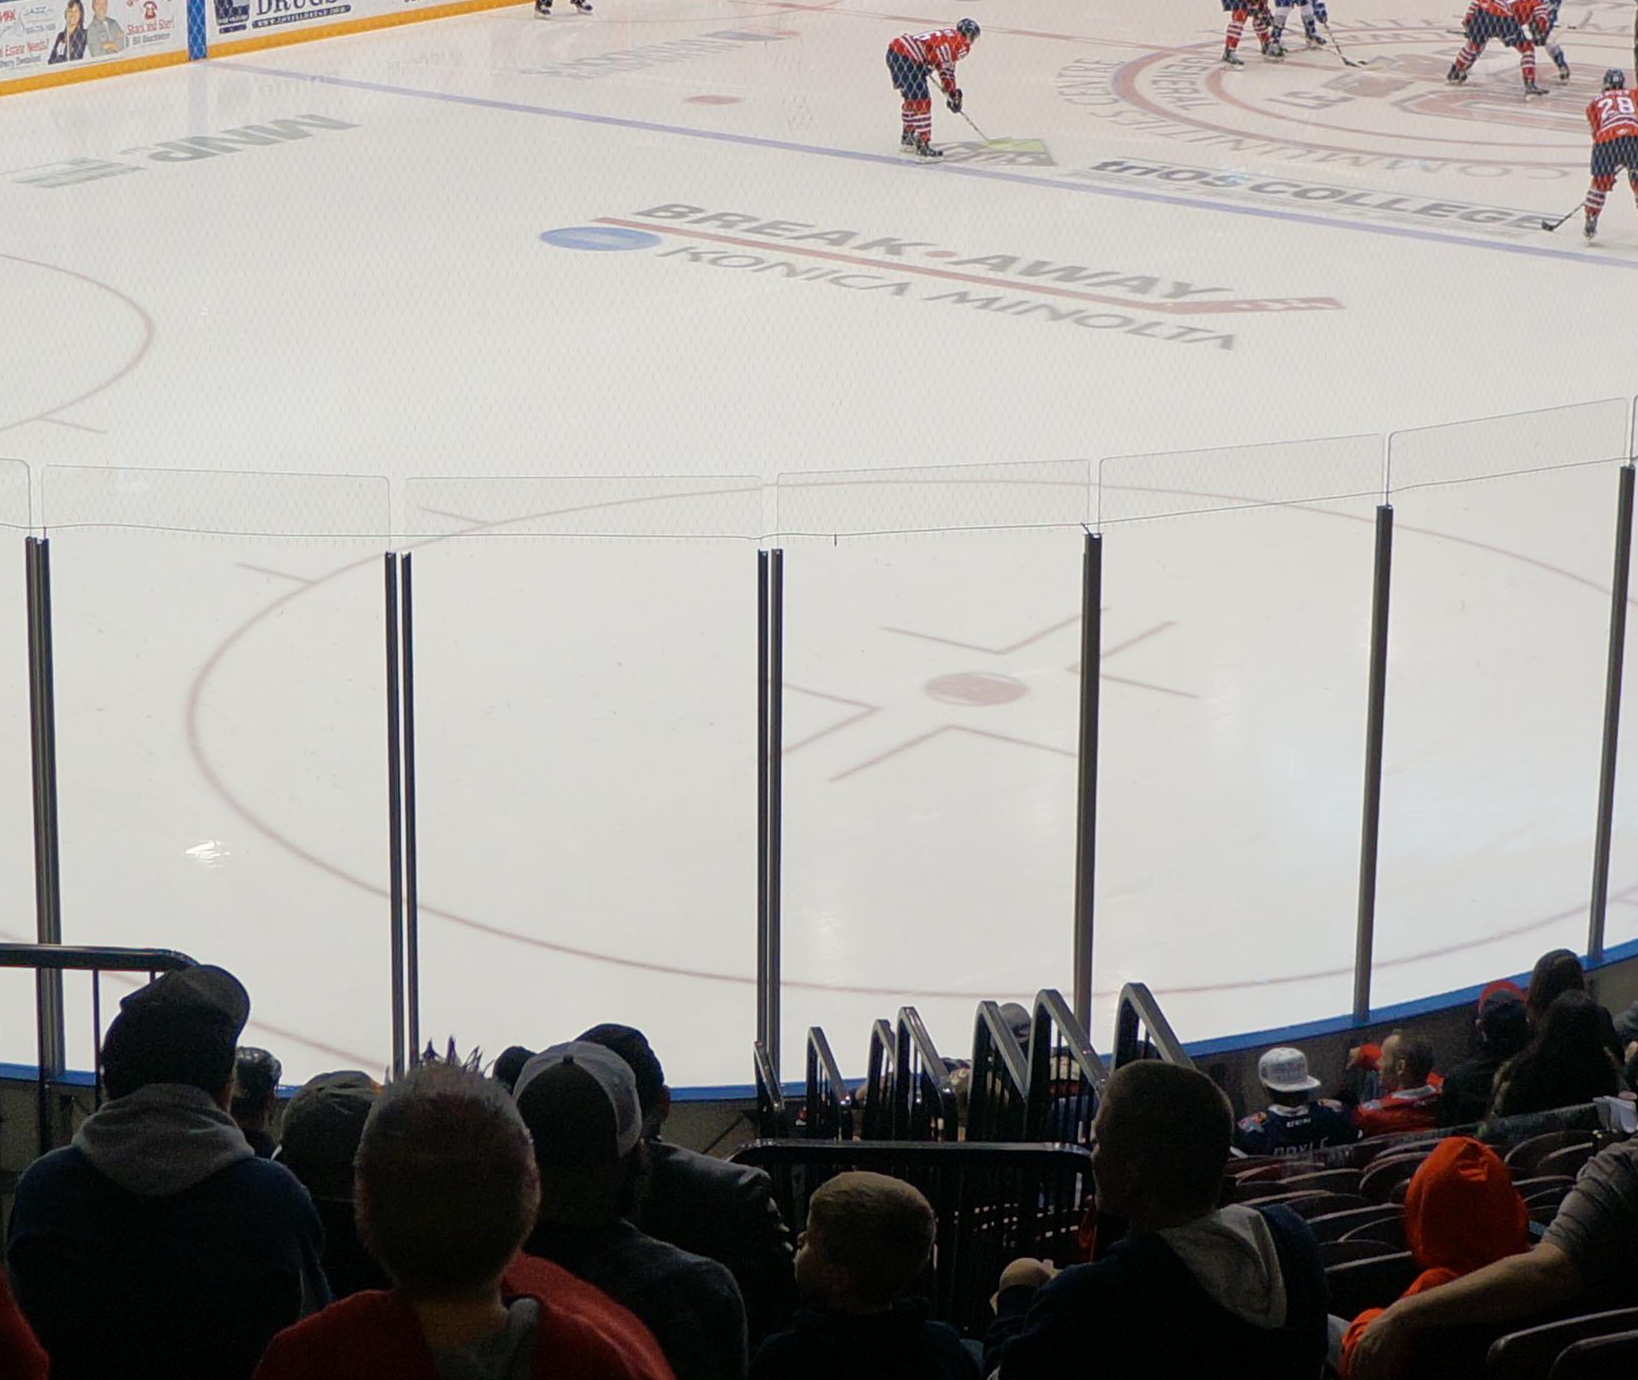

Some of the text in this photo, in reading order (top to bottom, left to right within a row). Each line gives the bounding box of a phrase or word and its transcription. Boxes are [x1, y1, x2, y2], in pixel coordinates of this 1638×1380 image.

[1597, 97, 1637, 120] 28
[1249, 180, 1559, 230] COLLEGE
[632, 202, 1232, 300] BREAK AWAY
[655, 246, 1237, 351] KONICA MINOLTA
